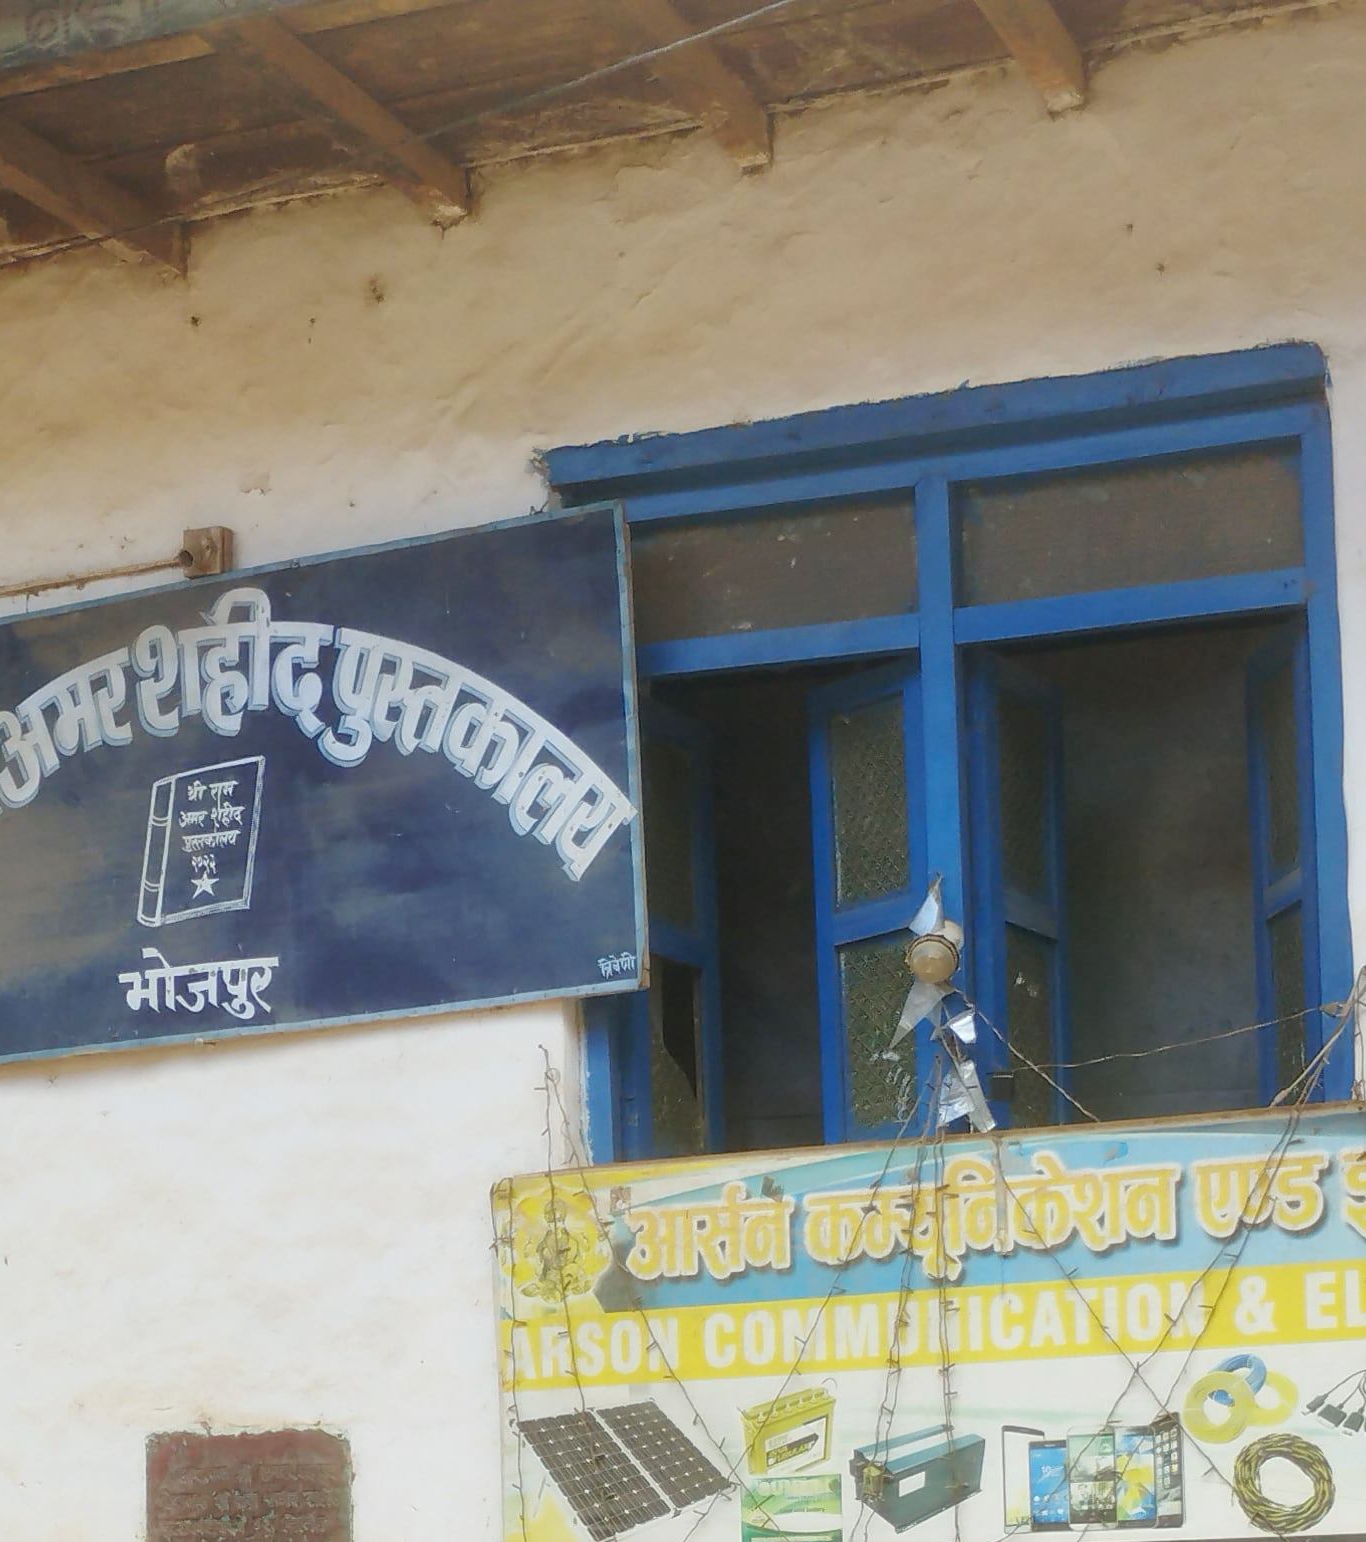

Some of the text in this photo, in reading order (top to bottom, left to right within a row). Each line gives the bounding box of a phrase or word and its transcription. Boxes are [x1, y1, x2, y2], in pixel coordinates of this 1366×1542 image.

[129, 586, 336, 741] शहीद
[319, 624, 638, 883] पुस्तकालय
[118, 948, 280, 1019] भोजपुर
[624, 1178, 798, 1283] आर्सन
[1191, 1149, 1333, 1236] एण्ड
[504, 1316, 680, 1381] ARSON
[702, 1278, 1207, 1370] COMMUNICATION
[1234, 1275, 1278, 1336] &
